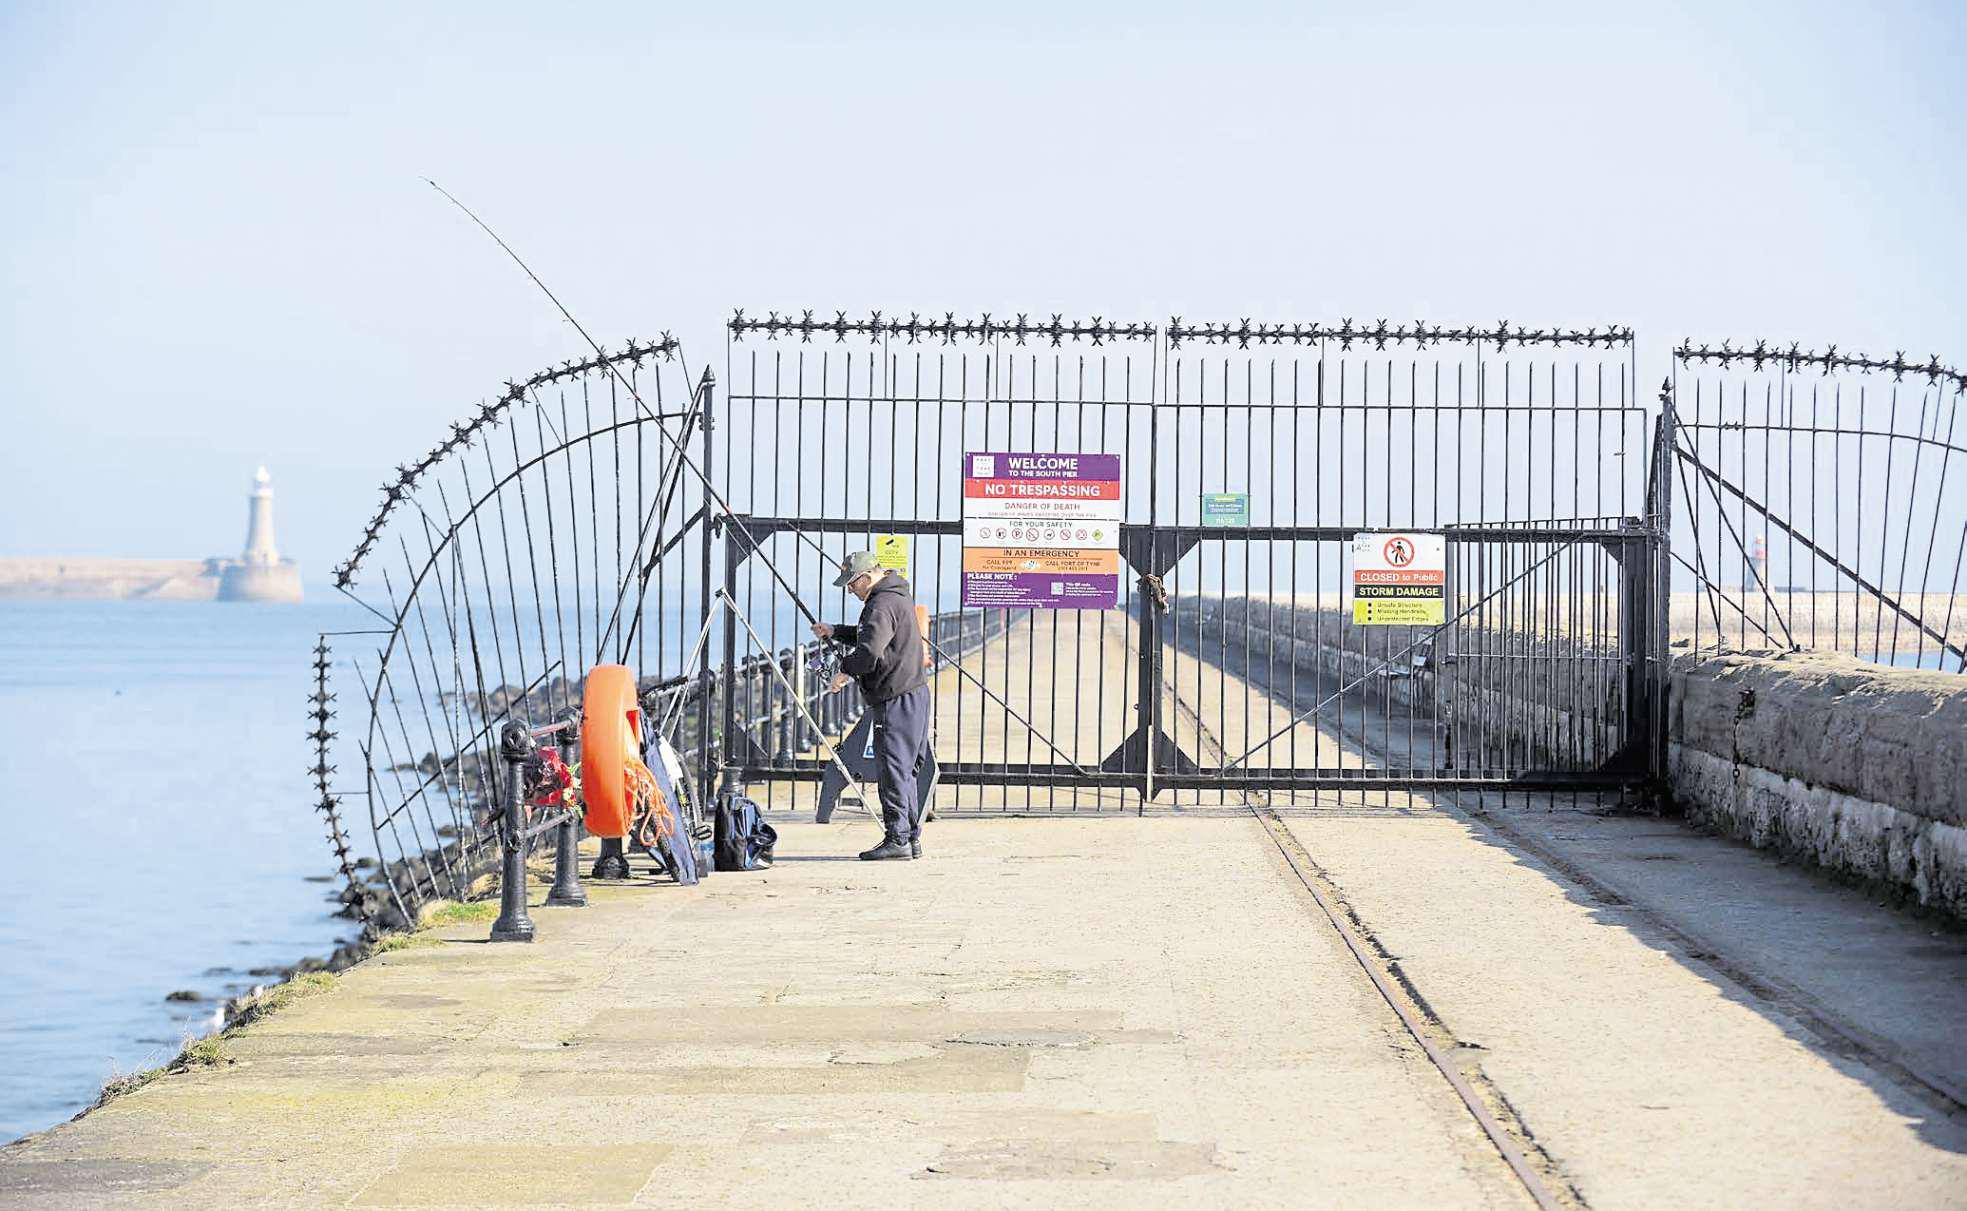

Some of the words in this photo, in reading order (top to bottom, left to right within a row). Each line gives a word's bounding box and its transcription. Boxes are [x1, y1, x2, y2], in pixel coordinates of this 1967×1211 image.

[1008, 457, 1078, 470] WELCOME
[985, 484, 1005, 495] NO
[1011, 484, 1100, 496] TRESPASSING
[1005, 502, 1037, 510] DANGER
[1054, 503, 1080, 511] DEATH
[1360, 573, 1400, 581] CLOSED
[1413, 573, 1438, 581] Public
[1360, 587, 1394, 595] STORM
[1397, 587, 1439, 596] DAMAGE
